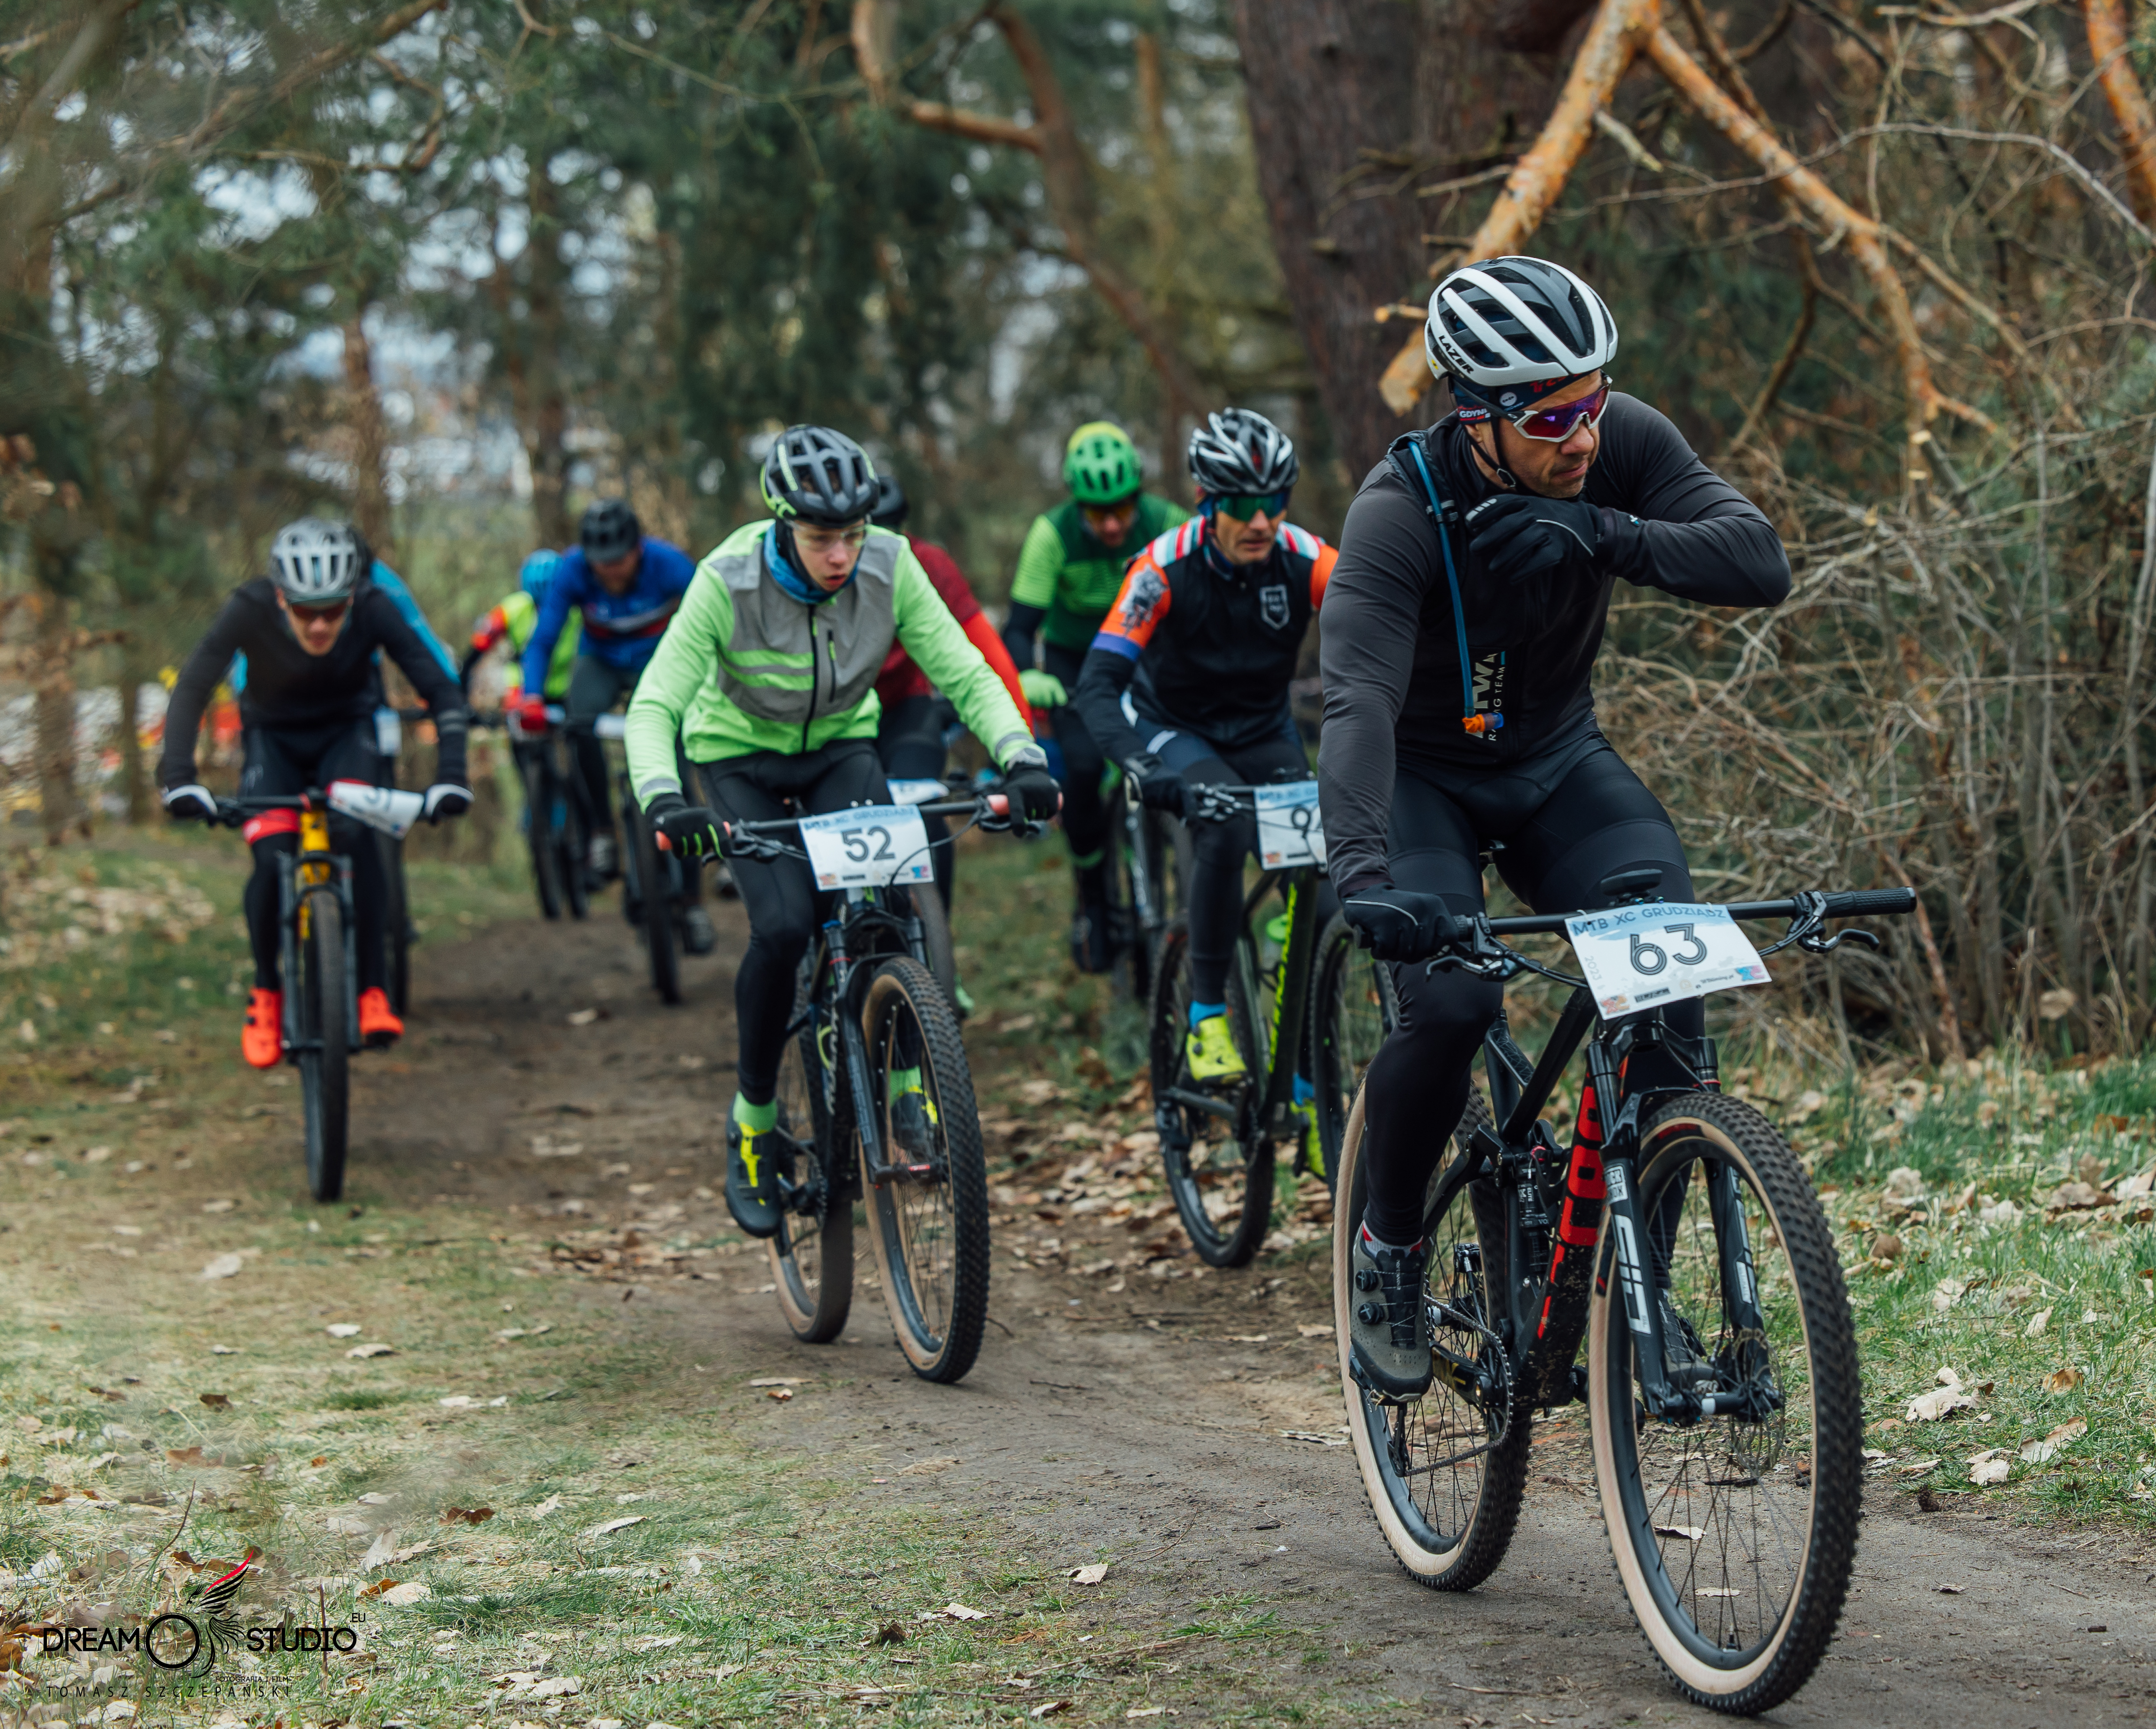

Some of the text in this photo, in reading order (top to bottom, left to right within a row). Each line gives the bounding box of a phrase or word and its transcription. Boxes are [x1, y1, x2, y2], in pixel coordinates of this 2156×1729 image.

[1438, 335, 1474, 375] LAZER
[1459, 408, 1488, 418] GDYNI
[1494, 667, 1506, 694] TEAM
[840, 825, 896, 862] 52
[1572, 918, 1609, 936] MTB
[1613, 911, 1636, 925] XC
[1630, 923, 1707, 975] 63
[1584, 955, 1603, 981] 2023
